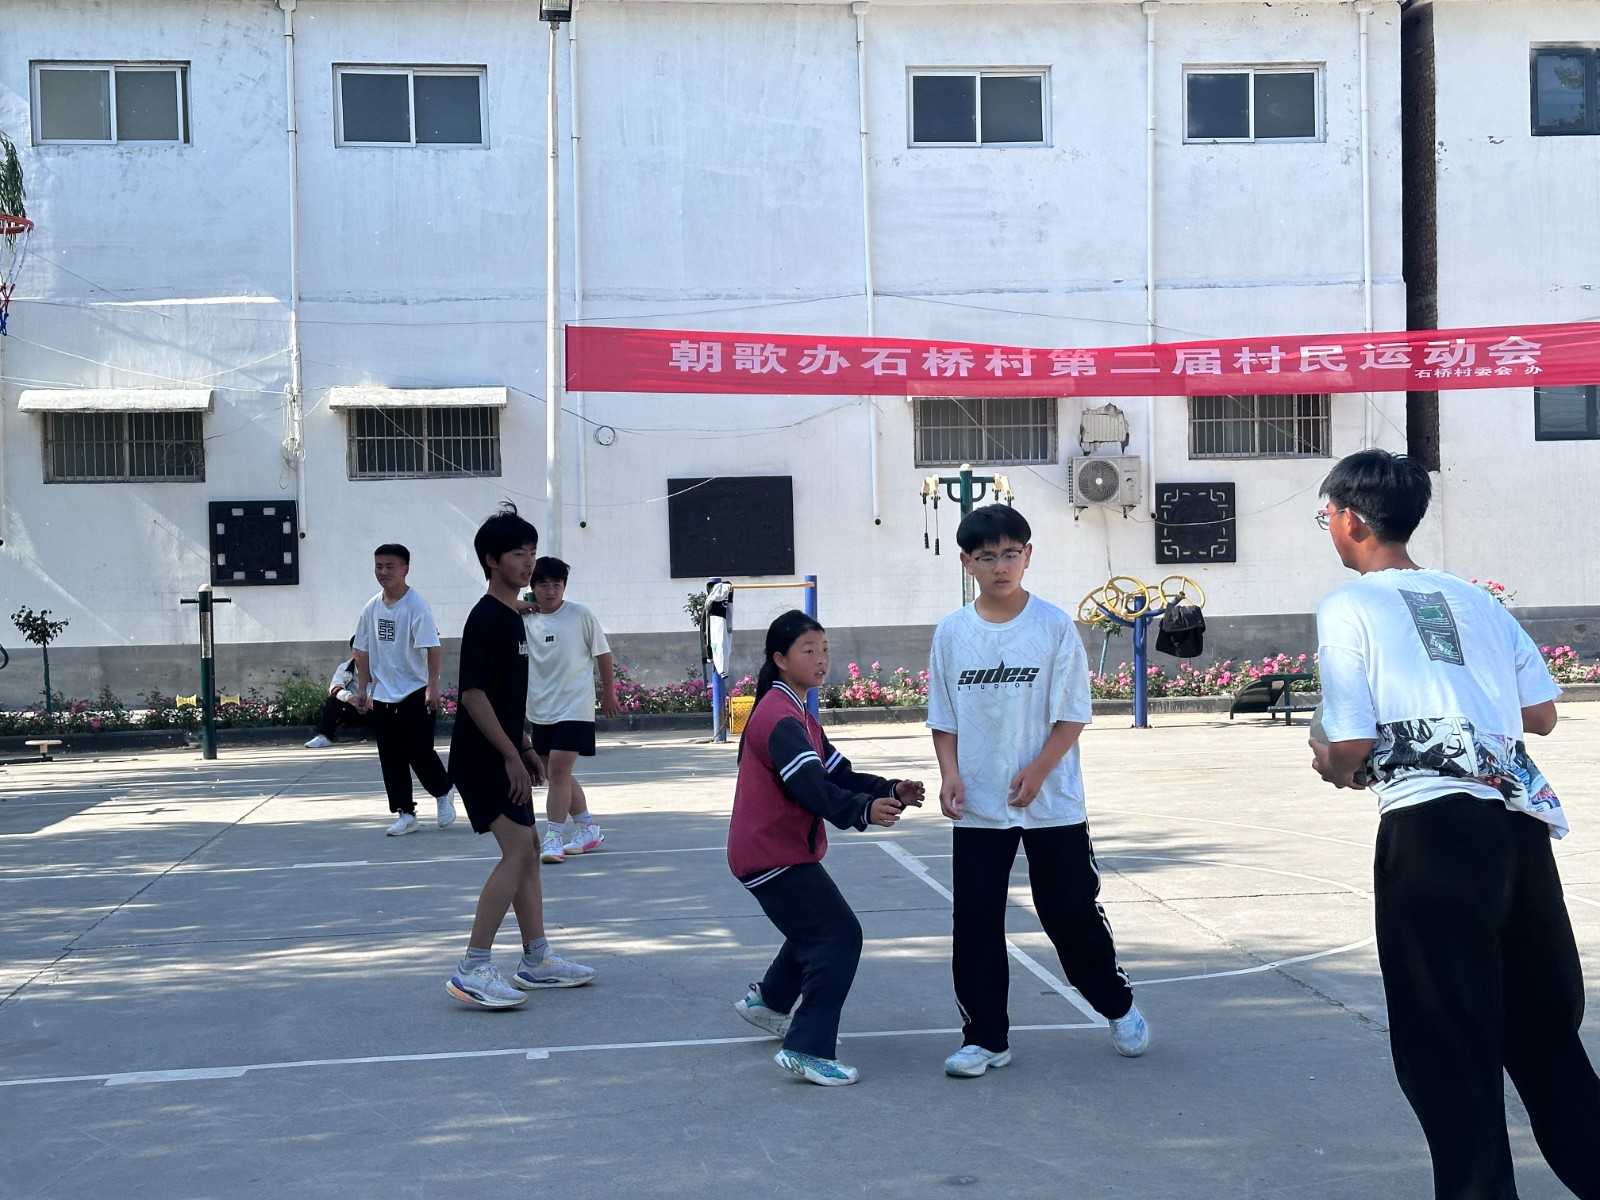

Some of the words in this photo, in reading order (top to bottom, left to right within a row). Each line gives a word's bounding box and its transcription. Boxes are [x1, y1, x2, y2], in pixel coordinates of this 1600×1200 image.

[668, 336, 1543, 378] 朝歌办石桥村第二届村民运动会
[1414, 366, 1513, 379] 石桥村委会
